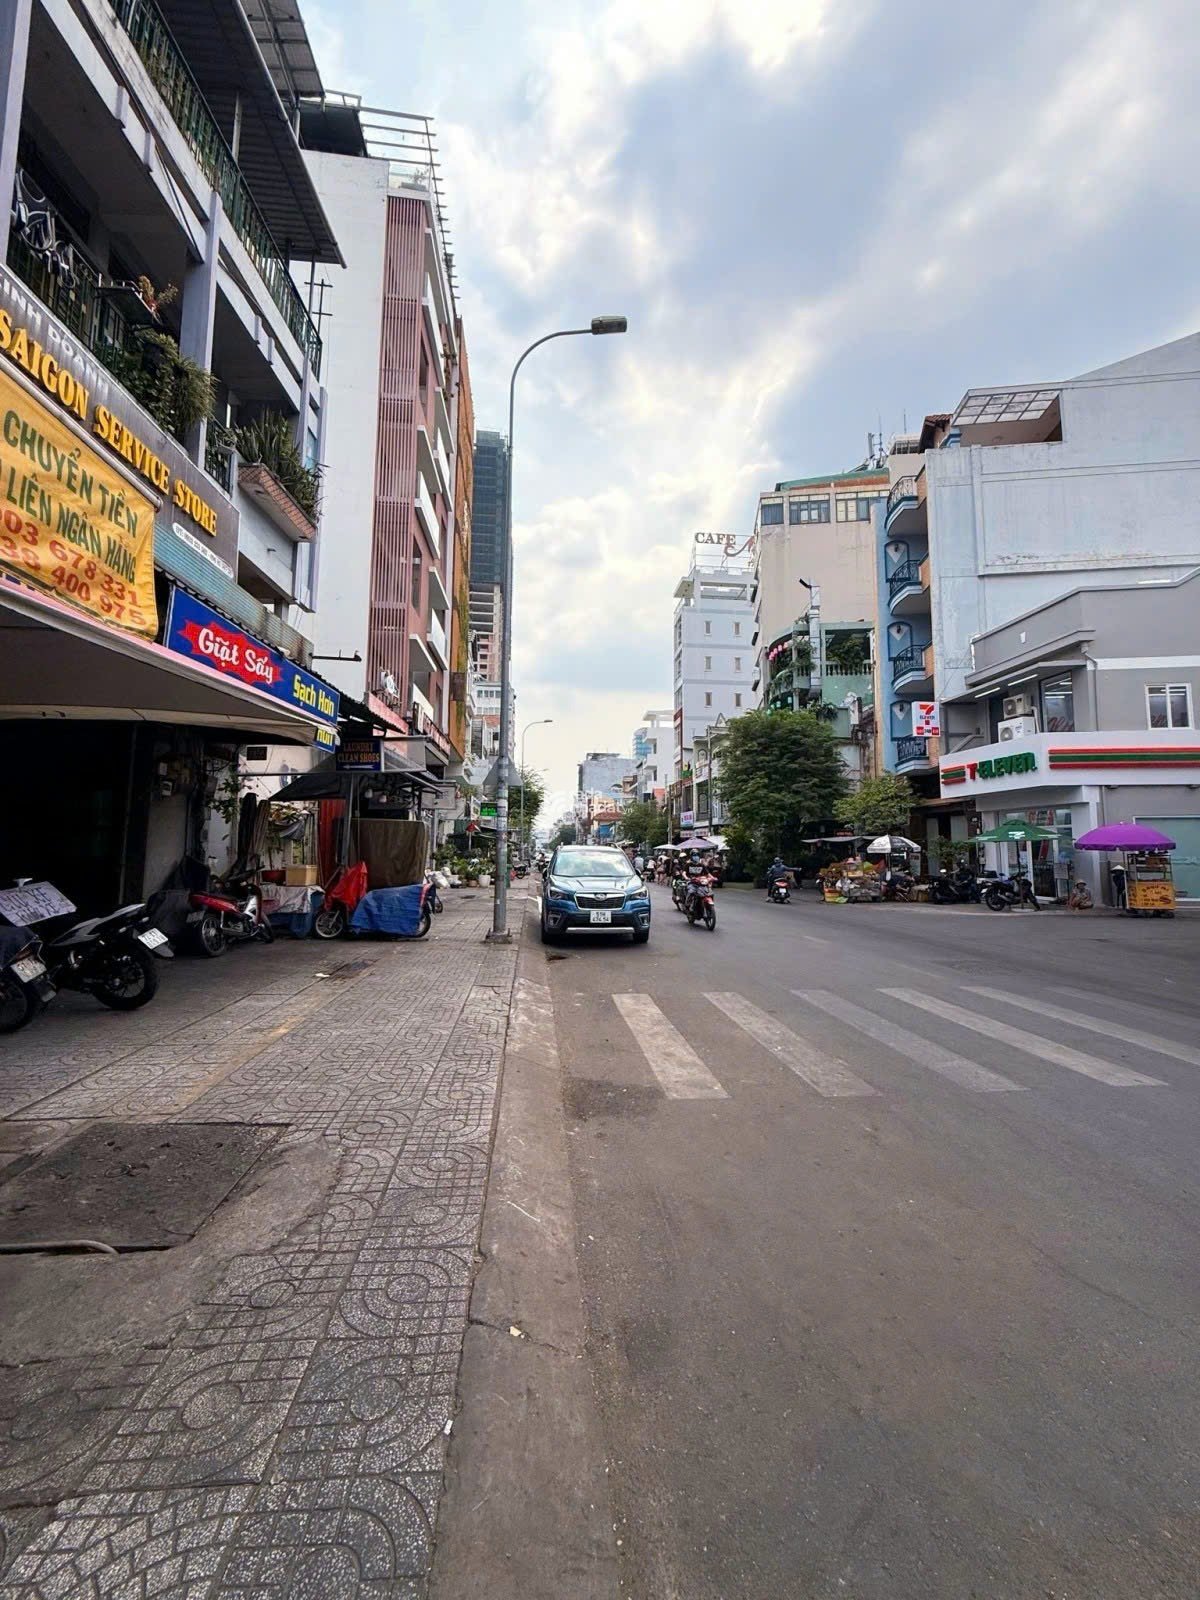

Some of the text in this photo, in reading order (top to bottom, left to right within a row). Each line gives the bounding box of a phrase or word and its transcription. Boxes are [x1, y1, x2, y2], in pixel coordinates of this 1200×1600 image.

[0, 272, 41, 328] INH
[0, 309, 217, 537] SAIGON SERVICE STORE
[3, 410, 138, 538] CHUYỂN TIỀN
[6, 466, 52, 526] LIÊN
[57, 502, 101, 557] NGÂN
[694, 532, 736, 545] CAFE
[0, 508, 140, 607] 03 678 331
[51, 565, 91, 602] 400
[100, 594, 147, 626] 975
[198, 627, 274, 685] Giặt Sấy
[293, 674, 317, 707] Sạch
[359, 752, 380, 762] SHOES
